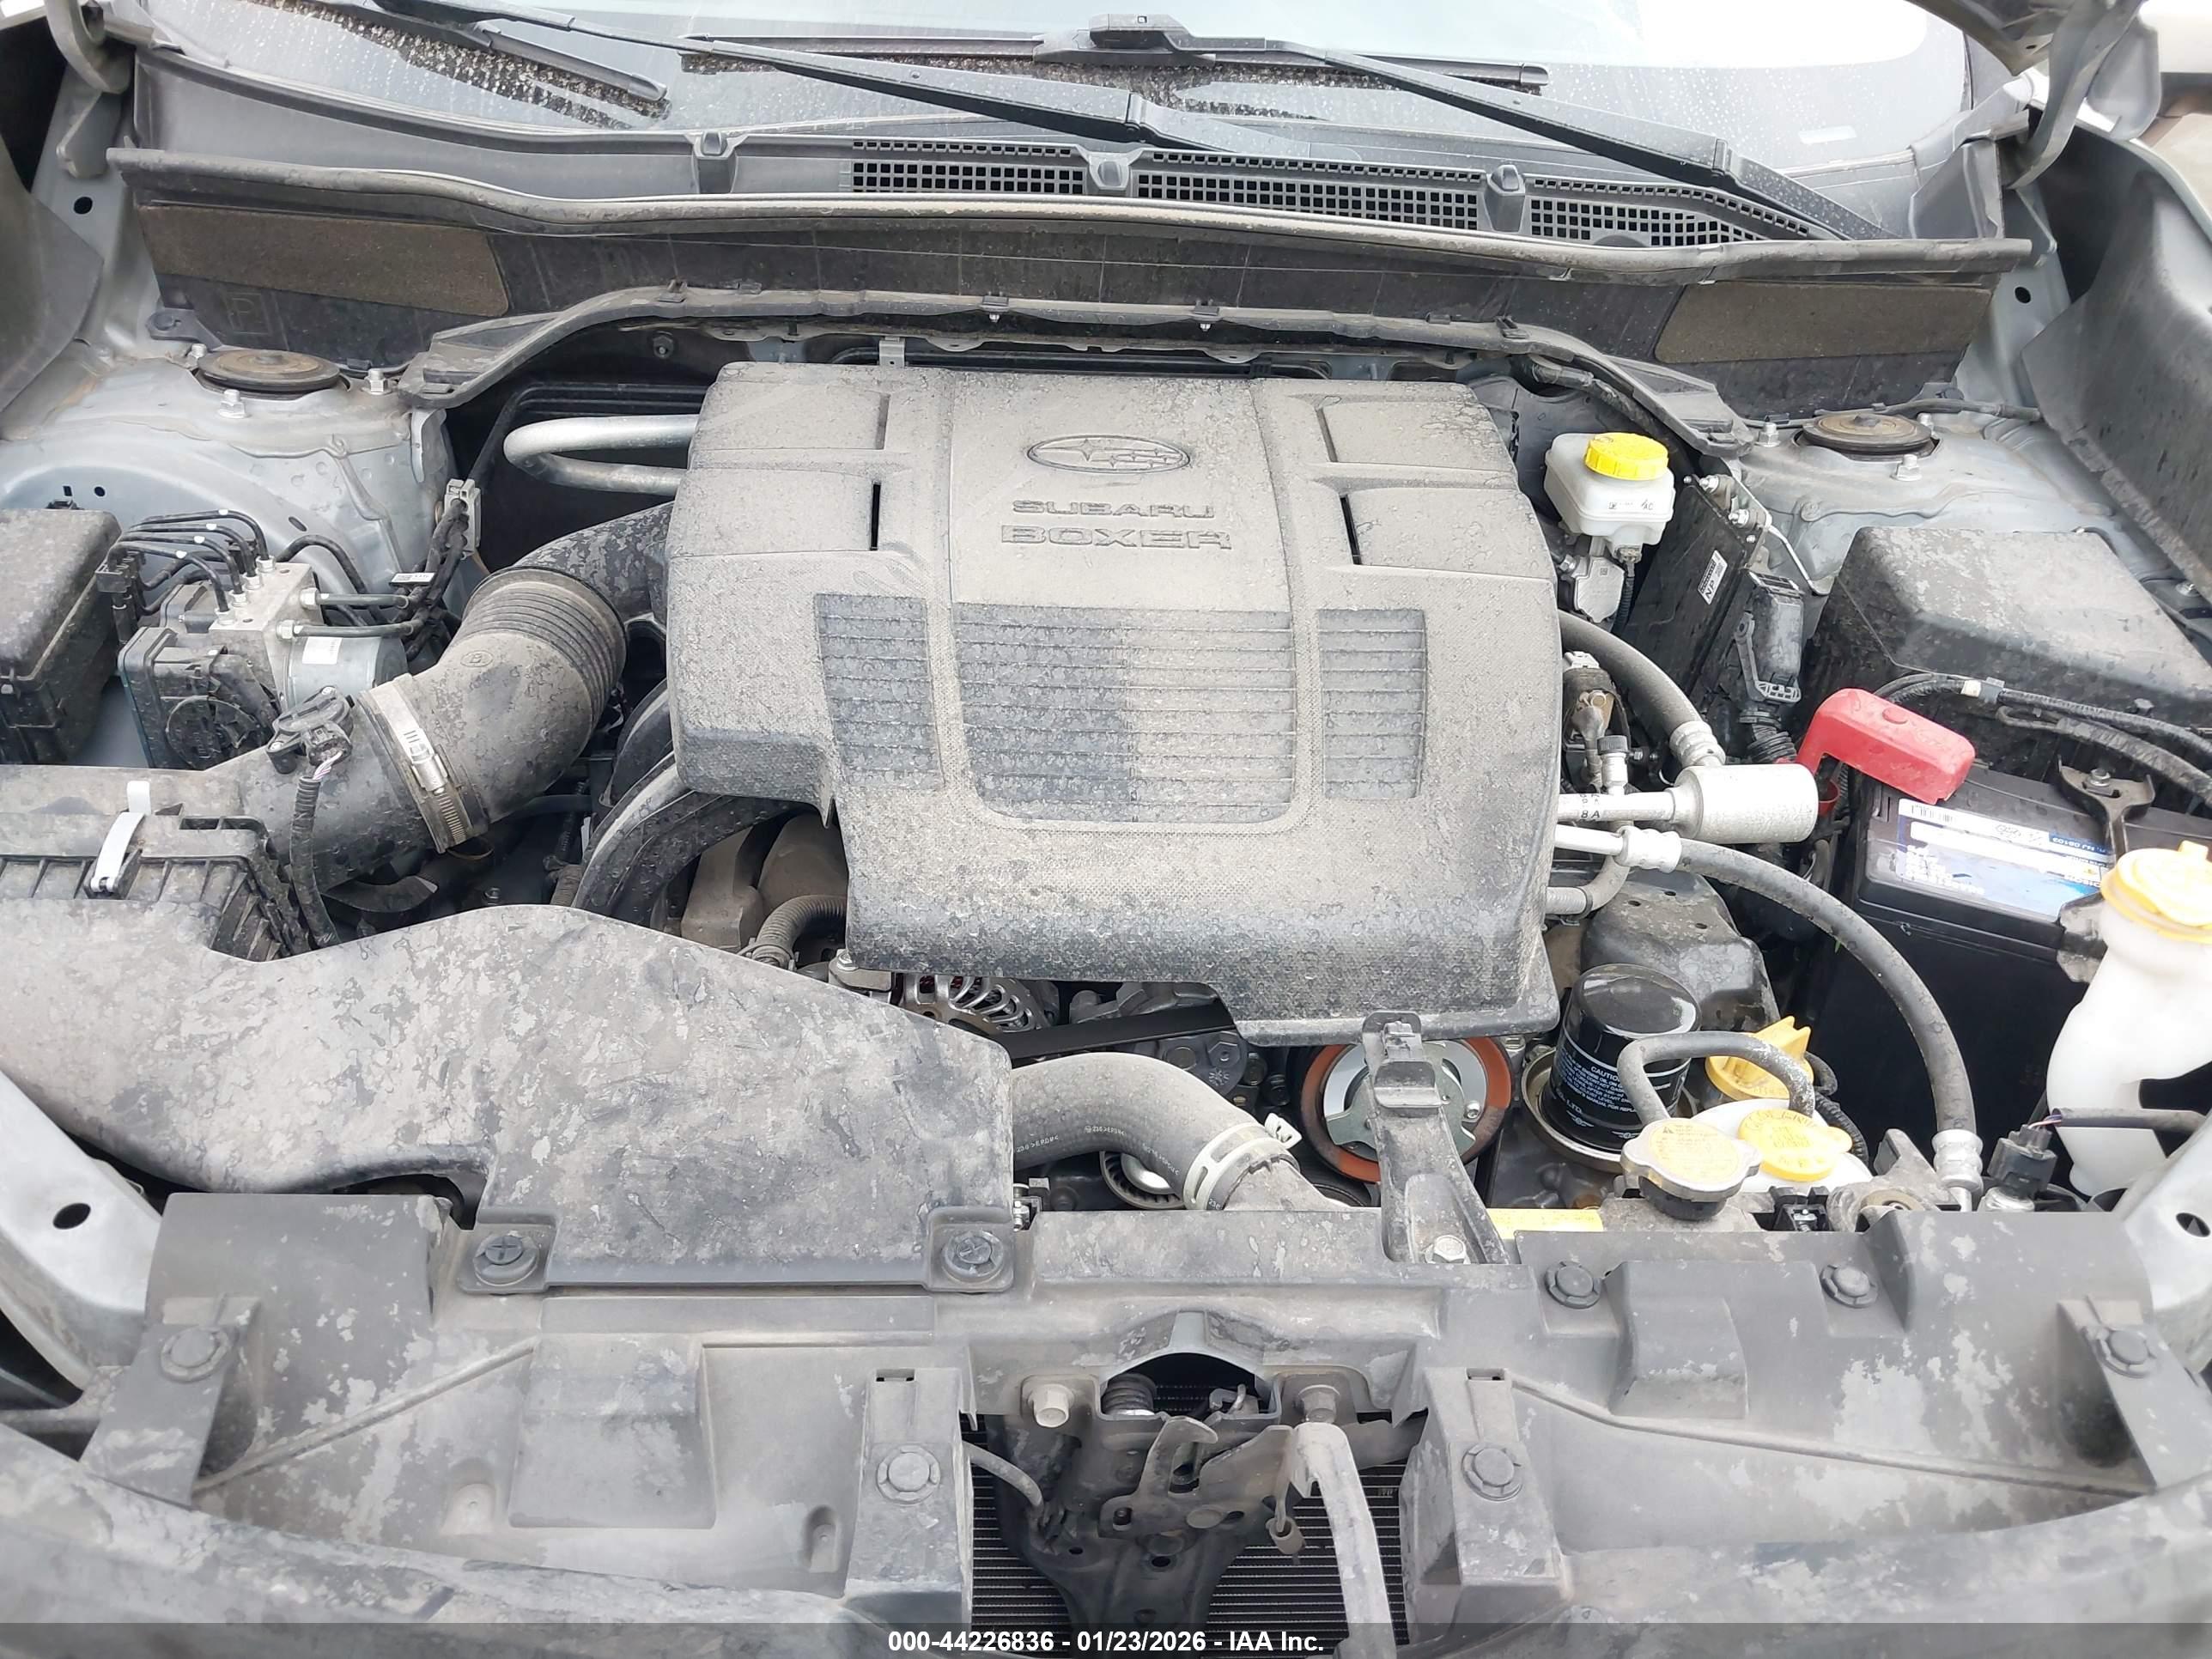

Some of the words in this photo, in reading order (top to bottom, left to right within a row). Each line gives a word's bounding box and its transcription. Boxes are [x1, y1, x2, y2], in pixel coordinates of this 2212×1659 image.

[1012, 500, 1215, 519] SUBARU
[1001, 525, 1233, 550] BOXER
[1590, 1066, 1621, 1082] CAUTIO
